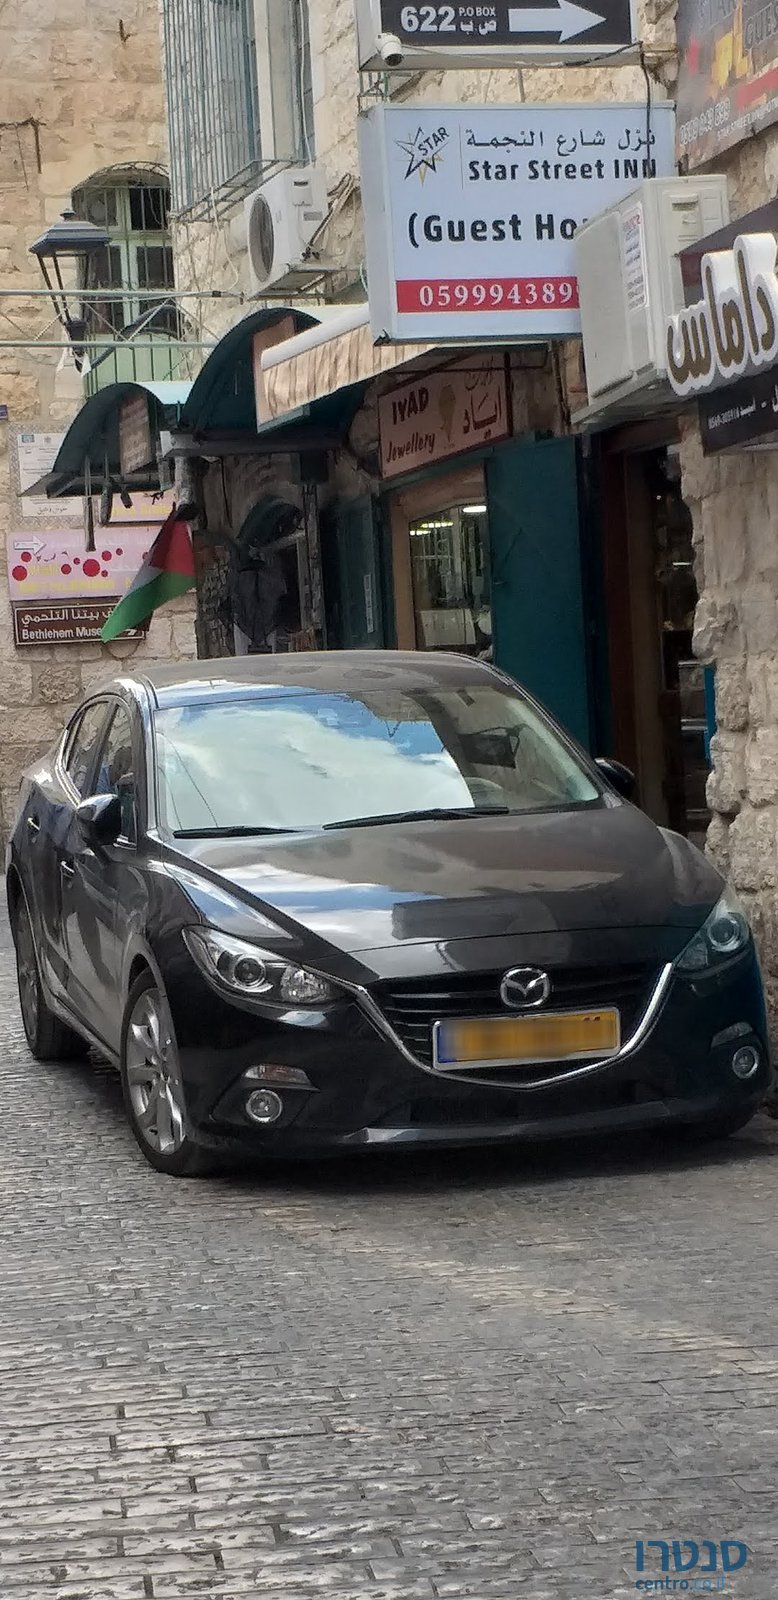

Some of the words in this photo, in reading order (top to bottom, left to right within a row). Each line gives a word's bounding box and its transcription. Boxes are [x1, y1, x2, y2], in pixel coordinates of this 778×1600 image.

[400, 6, 457, 32] 622
[476, 7, 497, 17] BOX
[418, 126, 450, 156] STAR
[465, 129, 544, 154] النجمة
[557, 128, 605, 157] شارع
[618, 128, 656, 151] نزل
[469, 159, 518, 181] Star
[528, 159, 605, 181] Street
[614, 159, 656, 179] INN
[408, 212, 522, 248] (Guest
[535, 213, 588, 241] Ho
[419, 284, 579, 308] 059994389
[666, 243, 777, 390] داماس
[391, 387, 430, 425] IYAD
[386, 431, 436, 463] Jewellery
[21, 609, 69, 628] التلحمي
[72, 608, 100, 621] بيتنا
[75, 626, 102, 638] Muse
